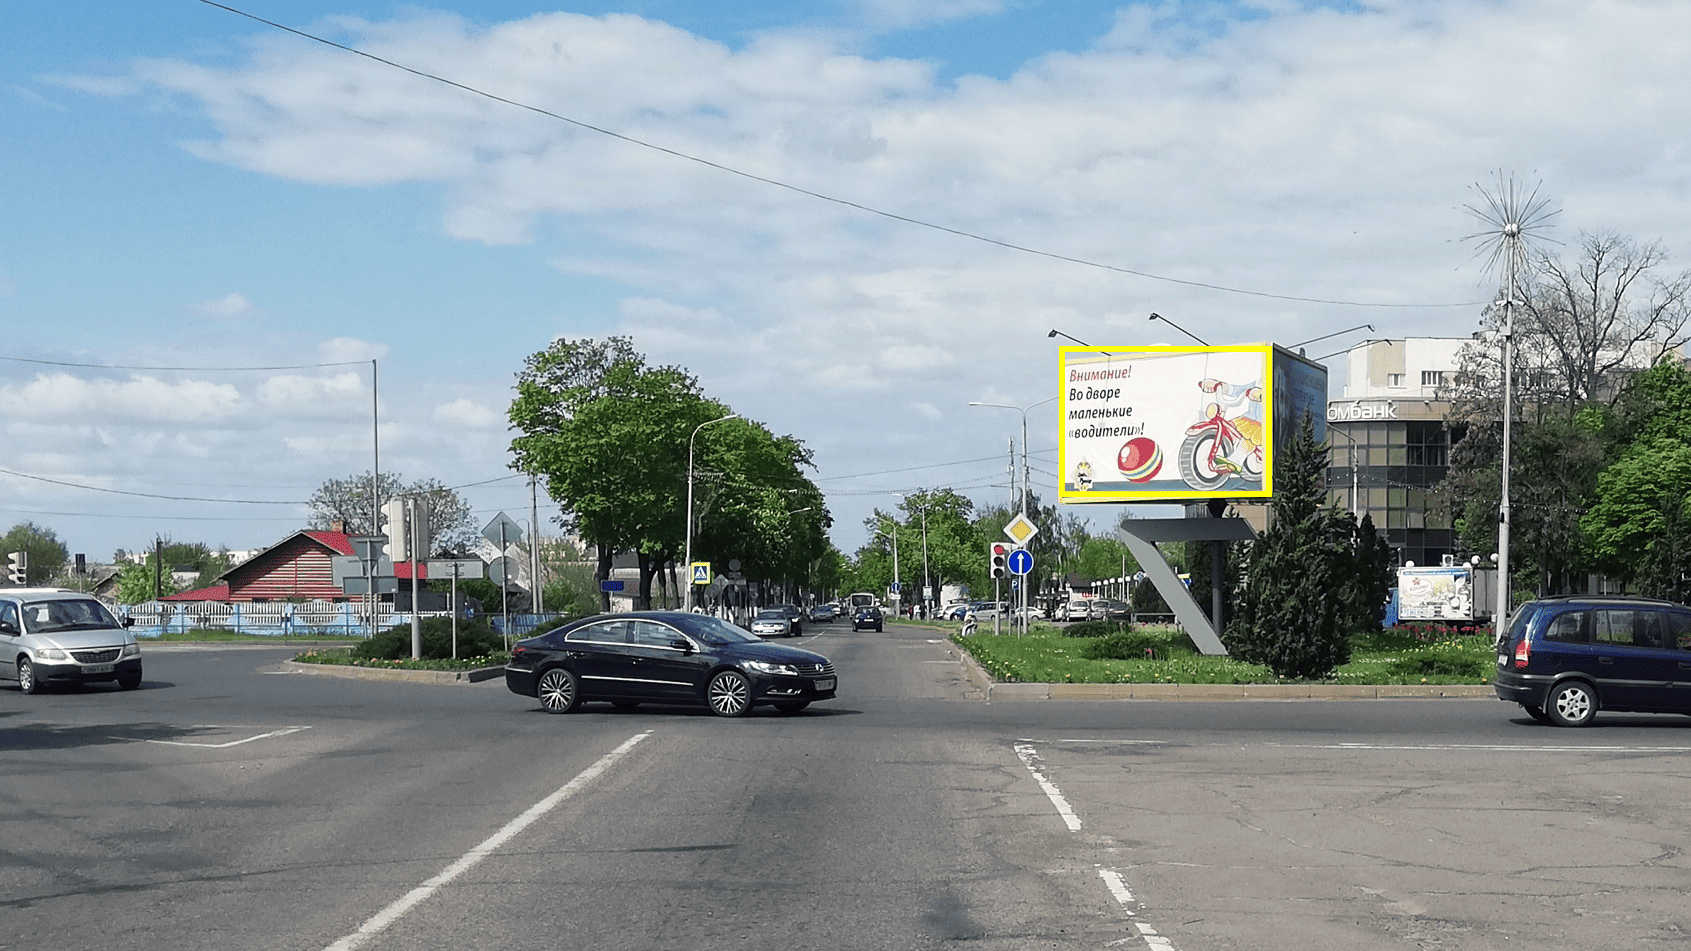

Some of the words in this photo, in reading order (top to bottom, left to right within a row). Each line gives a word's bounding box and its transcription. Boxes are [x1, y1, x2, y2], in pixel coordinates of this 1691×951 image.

[1069, 365, 1132, 382] Внимание!
[1069, 388, 1083, 401] Во
[1086, 386, 1121, 402] дворе
[1068, 406, 1133, 420] маленькие
[1068, 422, 1145, 439] «водители»!
[1012, 580, 1018, 589] P
